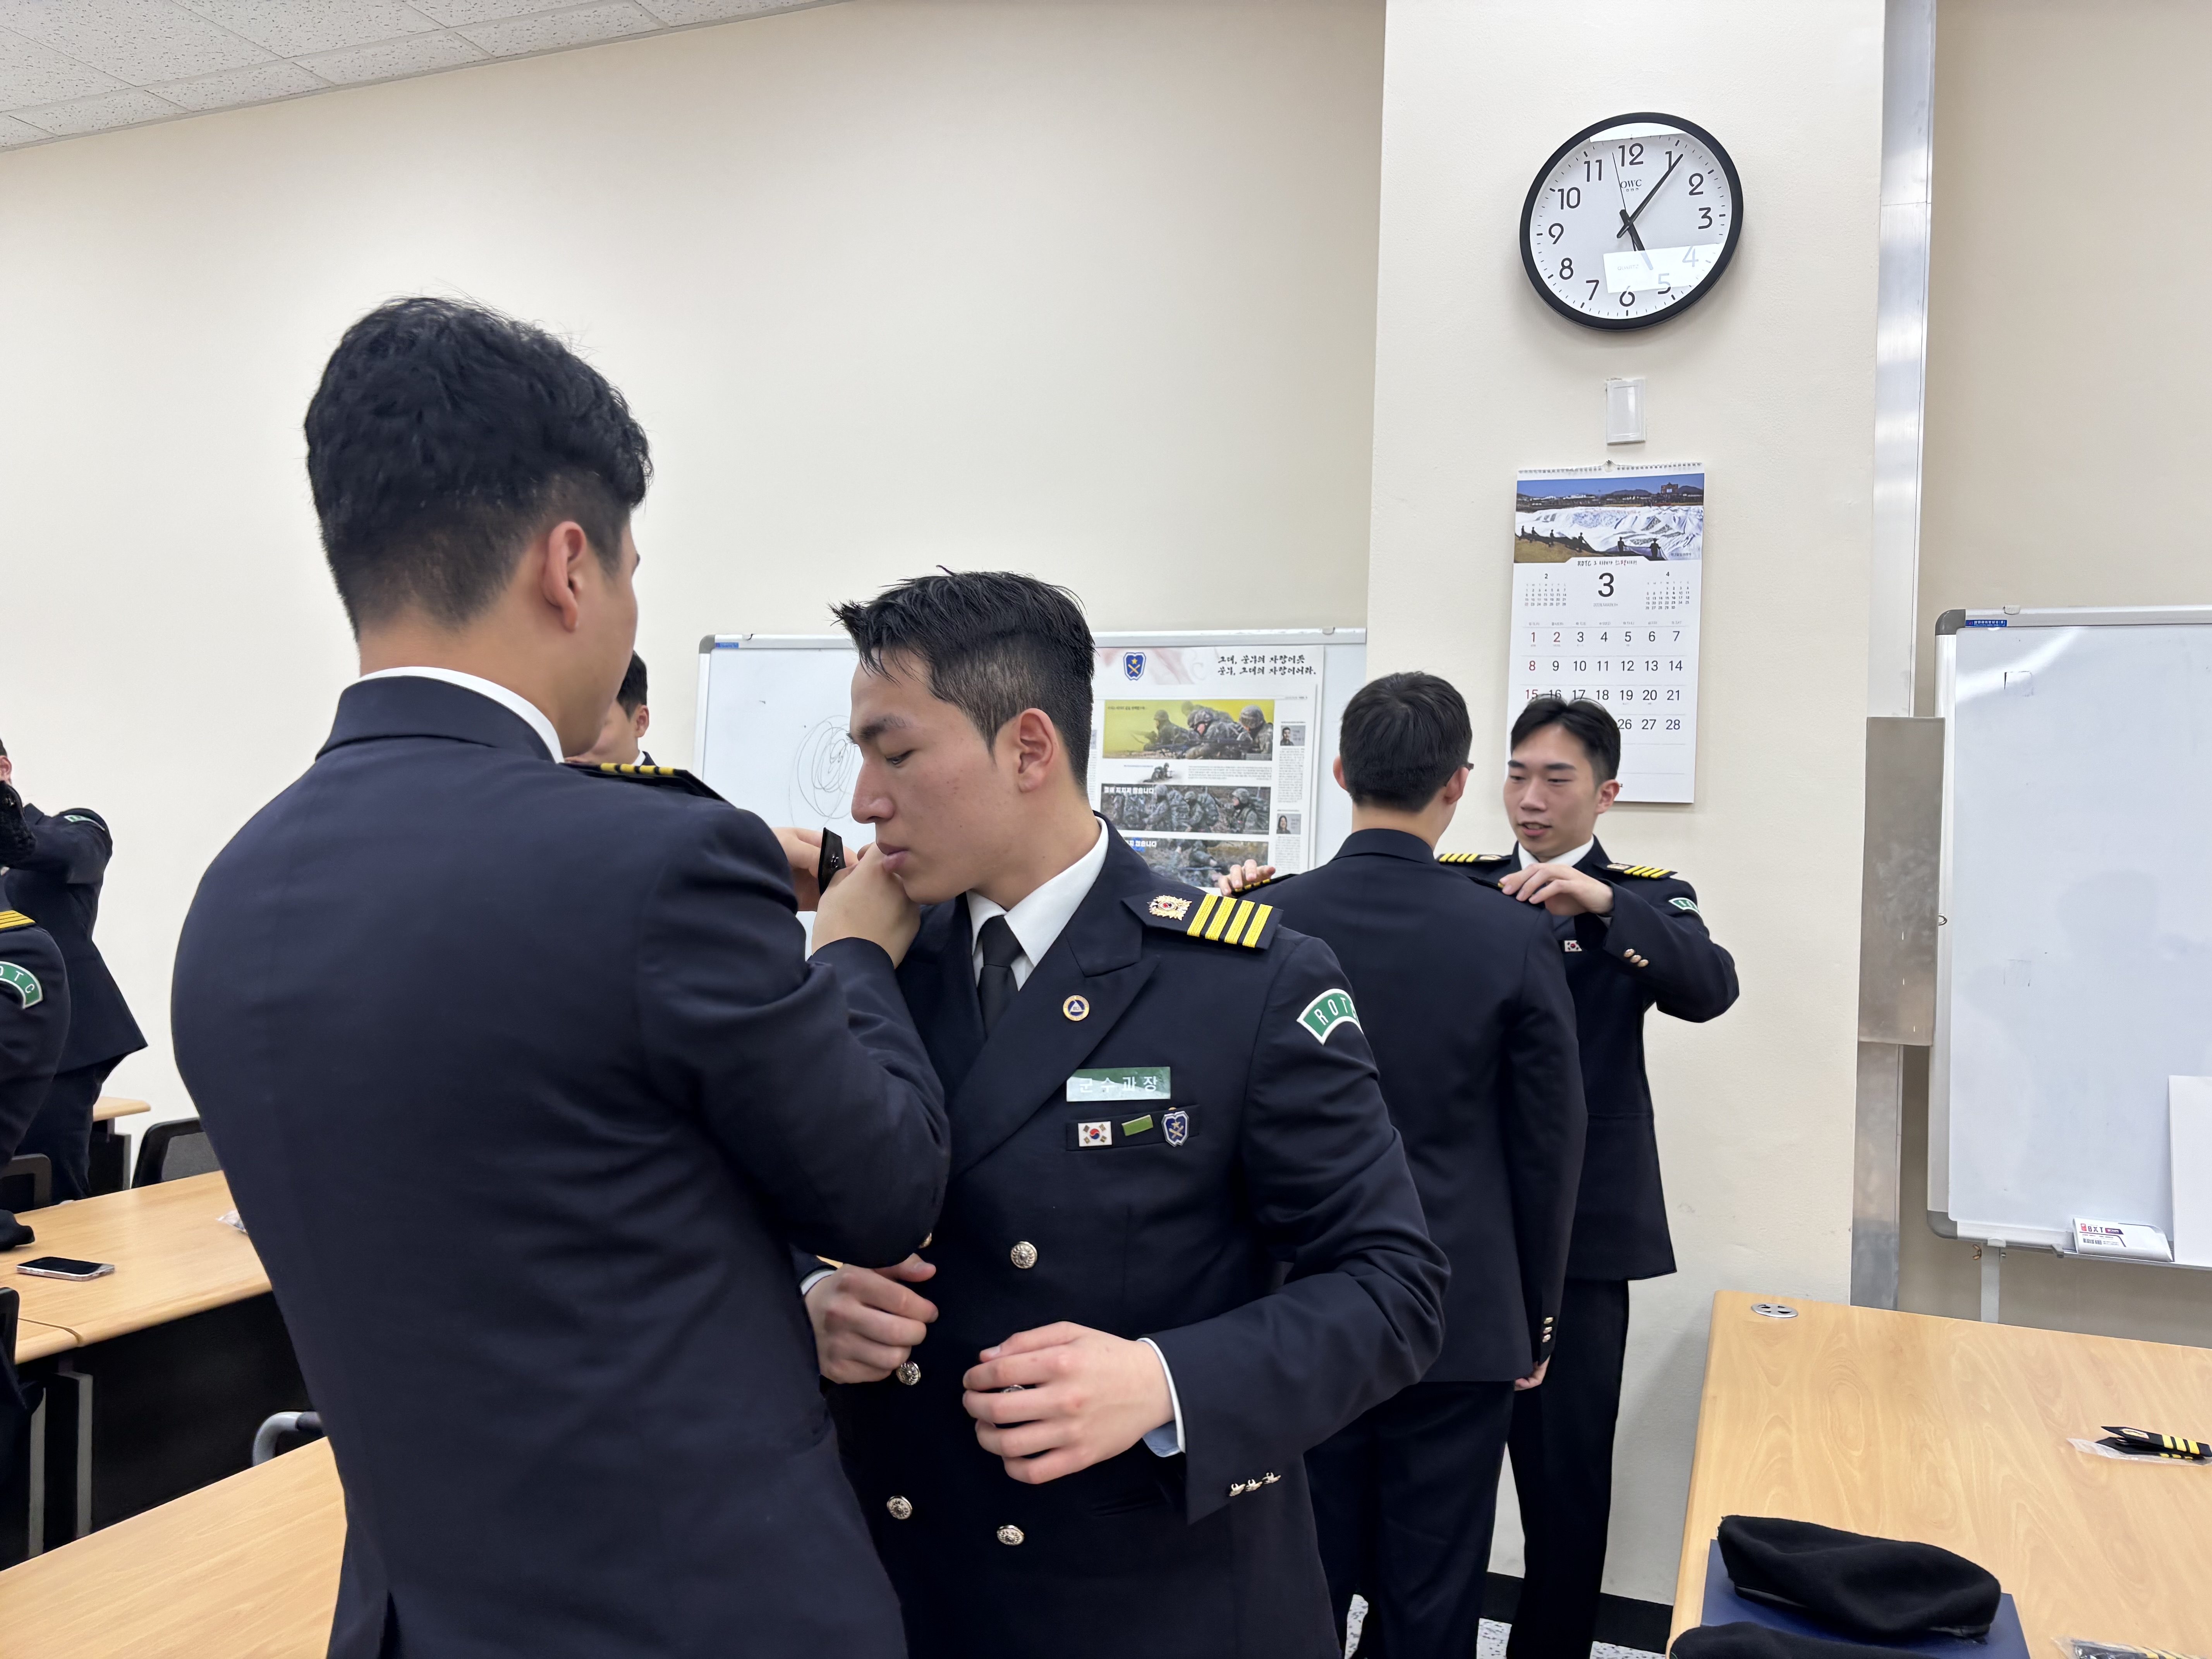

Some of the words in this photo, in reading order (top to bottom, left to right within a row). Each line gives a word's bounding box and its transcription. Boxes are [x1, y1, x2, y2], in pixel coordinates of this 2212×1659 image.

[1618, 143, 1644, 167] 12
[1665, 151, 1672, 171] 1
[1584, 160, 1602, 182] 11
[1689, 173, 1703, 196] 2
[1558, 187, 1580, 210] 10
[1698, 207, 1712, 229] 3
[1549, 223, 1564, 244] 9
[1682, 246, 1698, 267] 4
[1559, 258, 1573, 280] 8
[1586, 280, 1599, 300] 7
[1658, 273, 1671, 294] 5
[1620, 286, 1635, 307] 6
[1598, 573, 1614, 597] 3
[1532, 632, 1535, 642] 1
[1554, 632, 1560, 642] 2
[1577, 632, 1583, 642] 3
[1601, 632, 1607, 642] 4
[1625, 632, 1631, 642] 5
[1649, 631, 1655, 641] 6
[1673, 631, 1680, 641] 7
[1529, 661, 1535, 671] 8
[1553, 661, 1559, 671] 9
[1574, 661, 1586, 671] 10
[1598, 661, 1608, 671] 11
[1621, 661, 1634, 671] 12
[1645, 661, 1658, 671] 13
[1669, 660, 1682, 671] 14
[1549, 689, 1561, 700] 16
[1573, 689, 1585, 700] 17
[1596, 690, 1609, 700] 18
[1620, 690, 1633, 700] 19
[1643, 690, 1657, 700] 20
[1667, 690, 1679, 700] 21
[1618, 719, 1632, 729] 26
[1642, 719, 1656, 730] 27
[1666, 720, 1680, 730] 28
[1079, 1076, 1158, 1093] 군수과장
